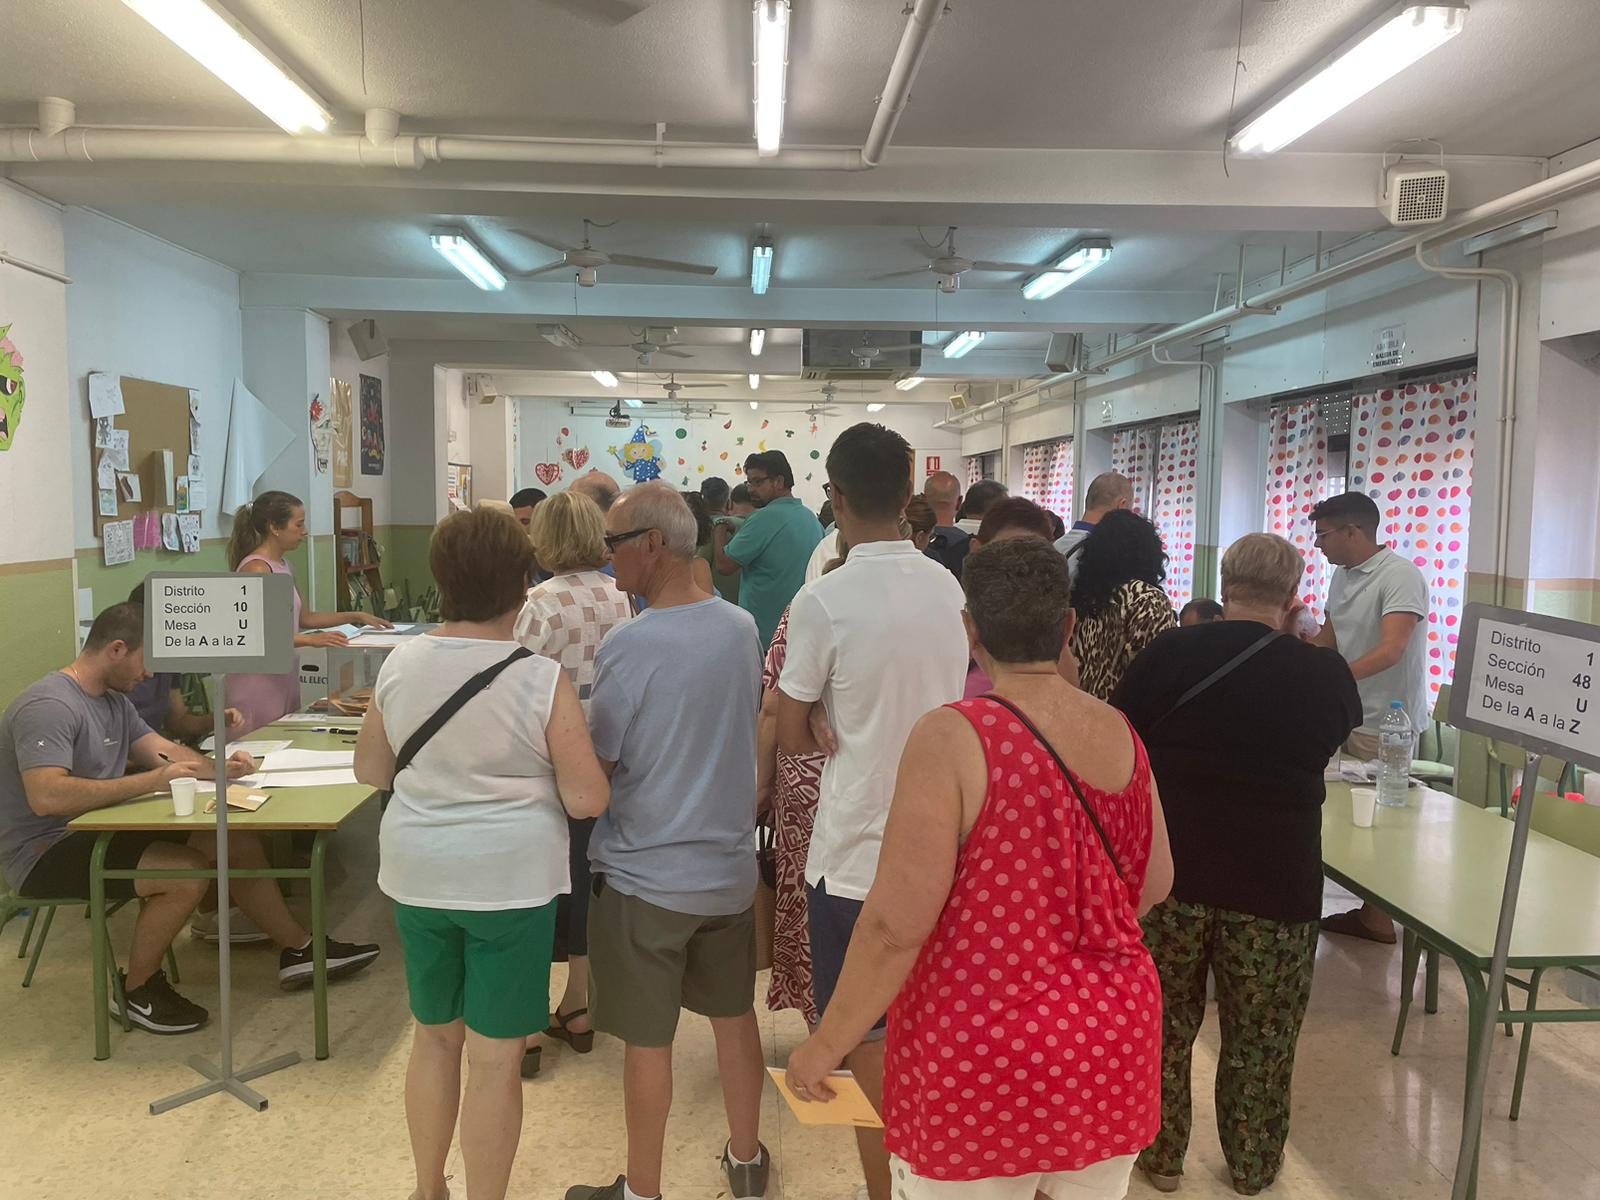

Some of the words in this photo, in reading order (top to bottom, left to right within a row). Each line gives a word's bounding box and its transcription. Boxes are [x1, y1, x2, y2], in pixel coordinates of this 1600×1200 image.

[164, 585, 205, 597] Distrito
[240, 585, 247, 596] 1
[164, 602, 211, 614] Sección
[233, 602, 248, 612] 10
[164, 619, 197, 631] Mesa
[238, 619, 248, 630] U
[165, 636, 182, 647] De
[185, 636, 195, 647] la
[198, 636, 208, 646] A
[212, 638, 219, 646] a
[223, 635, 233, 646] la
[237, 635, 246, 646] Z
[1491, 630, 1541, 654] Distrito
[1586, 652, 1594, 667] 1
[1487, 653, 1545, 679] Sección
[1572, 673, 1591, 690] 48
[1485, 674, 1524, 696] Mesa
[1576, 698, 1588, 713] U
[1482, 694, 1503, 712] De
[1507, 701, 1520, 717] la
[1523, 706, 1535, 721] A
[1539, 713, 1549, 725] a
[1553, 714, 1565, 730] la
[1569, 719, 1581, 735] Z
